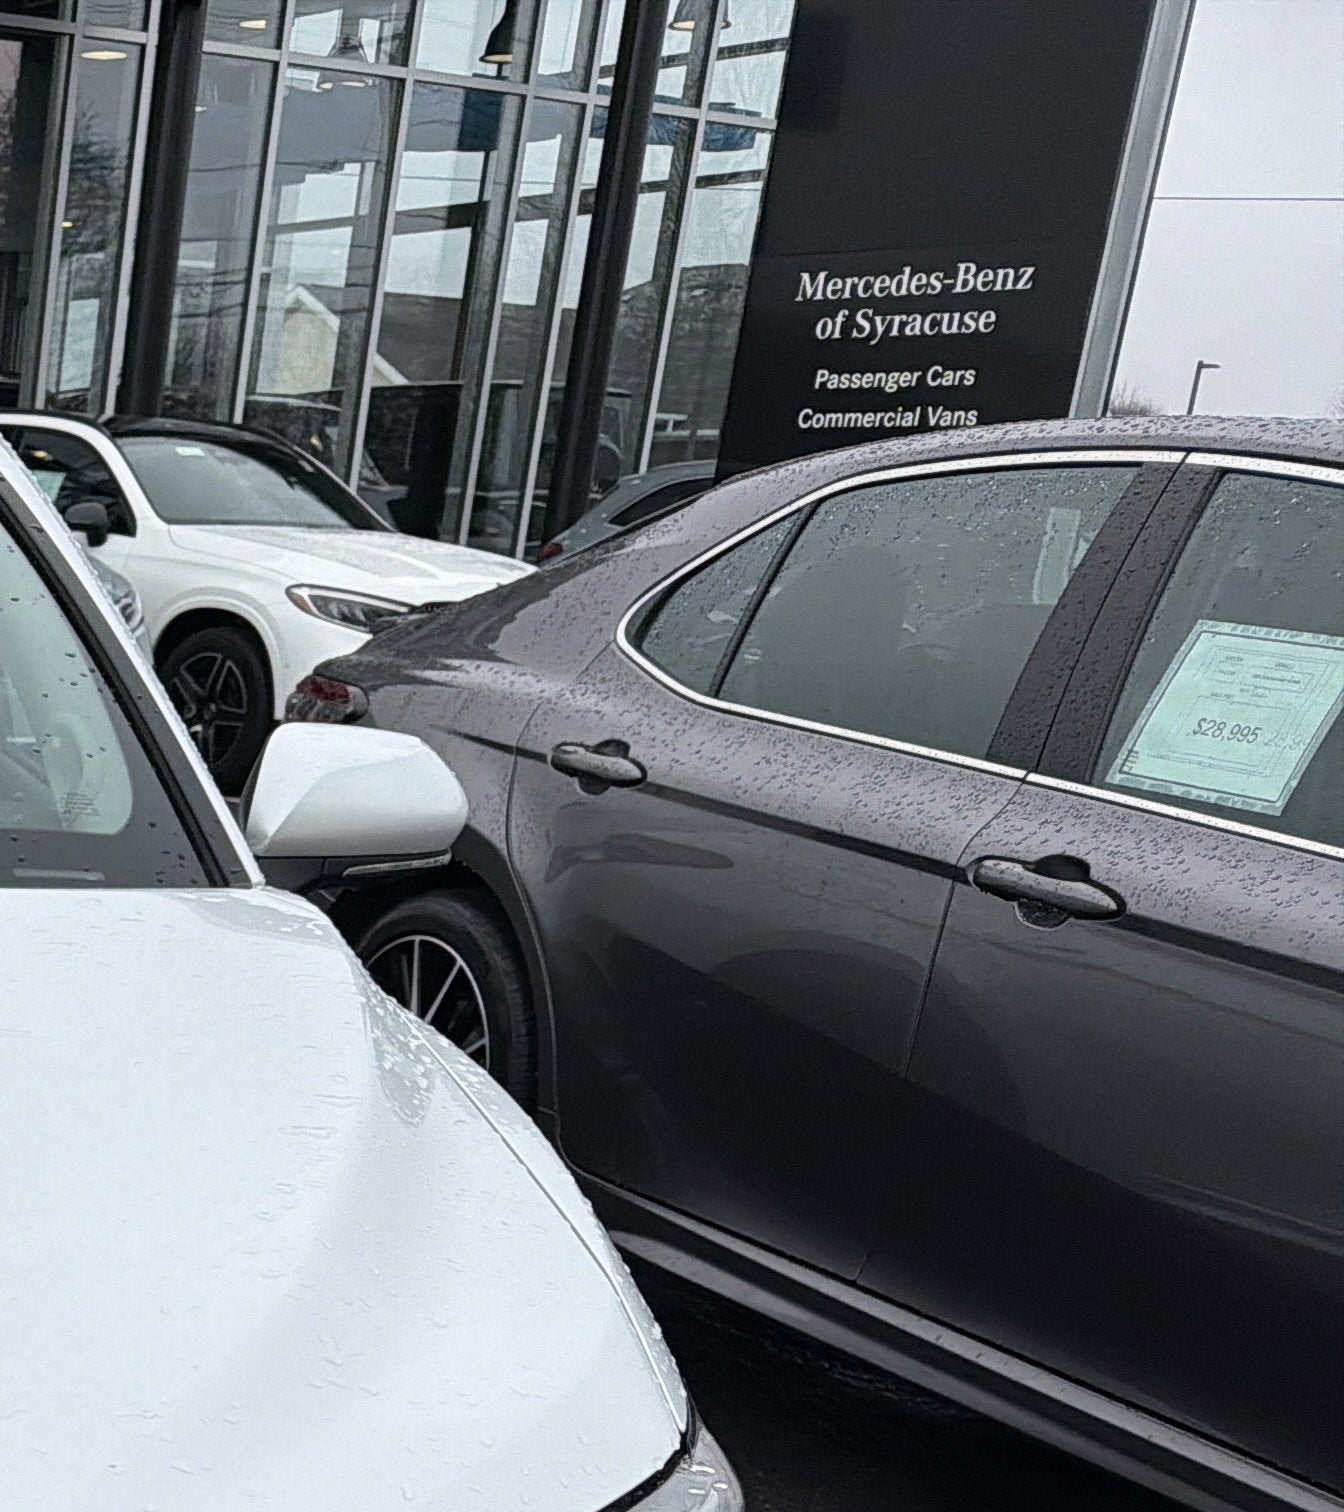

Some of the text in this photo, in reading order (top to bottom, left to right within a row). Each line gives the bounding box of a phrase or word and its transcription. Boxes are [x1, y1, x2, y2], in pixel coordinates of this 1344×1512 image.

[794, 261, 1036, 302] Mercedes-Benz
[815, 307, 997, 346] of Syracuse
[814, 365, 976, 393] Passenger Cars
[797, 405, 979, 429] Commercial Vans
[1192, 717, 1262, 744] $28,995
